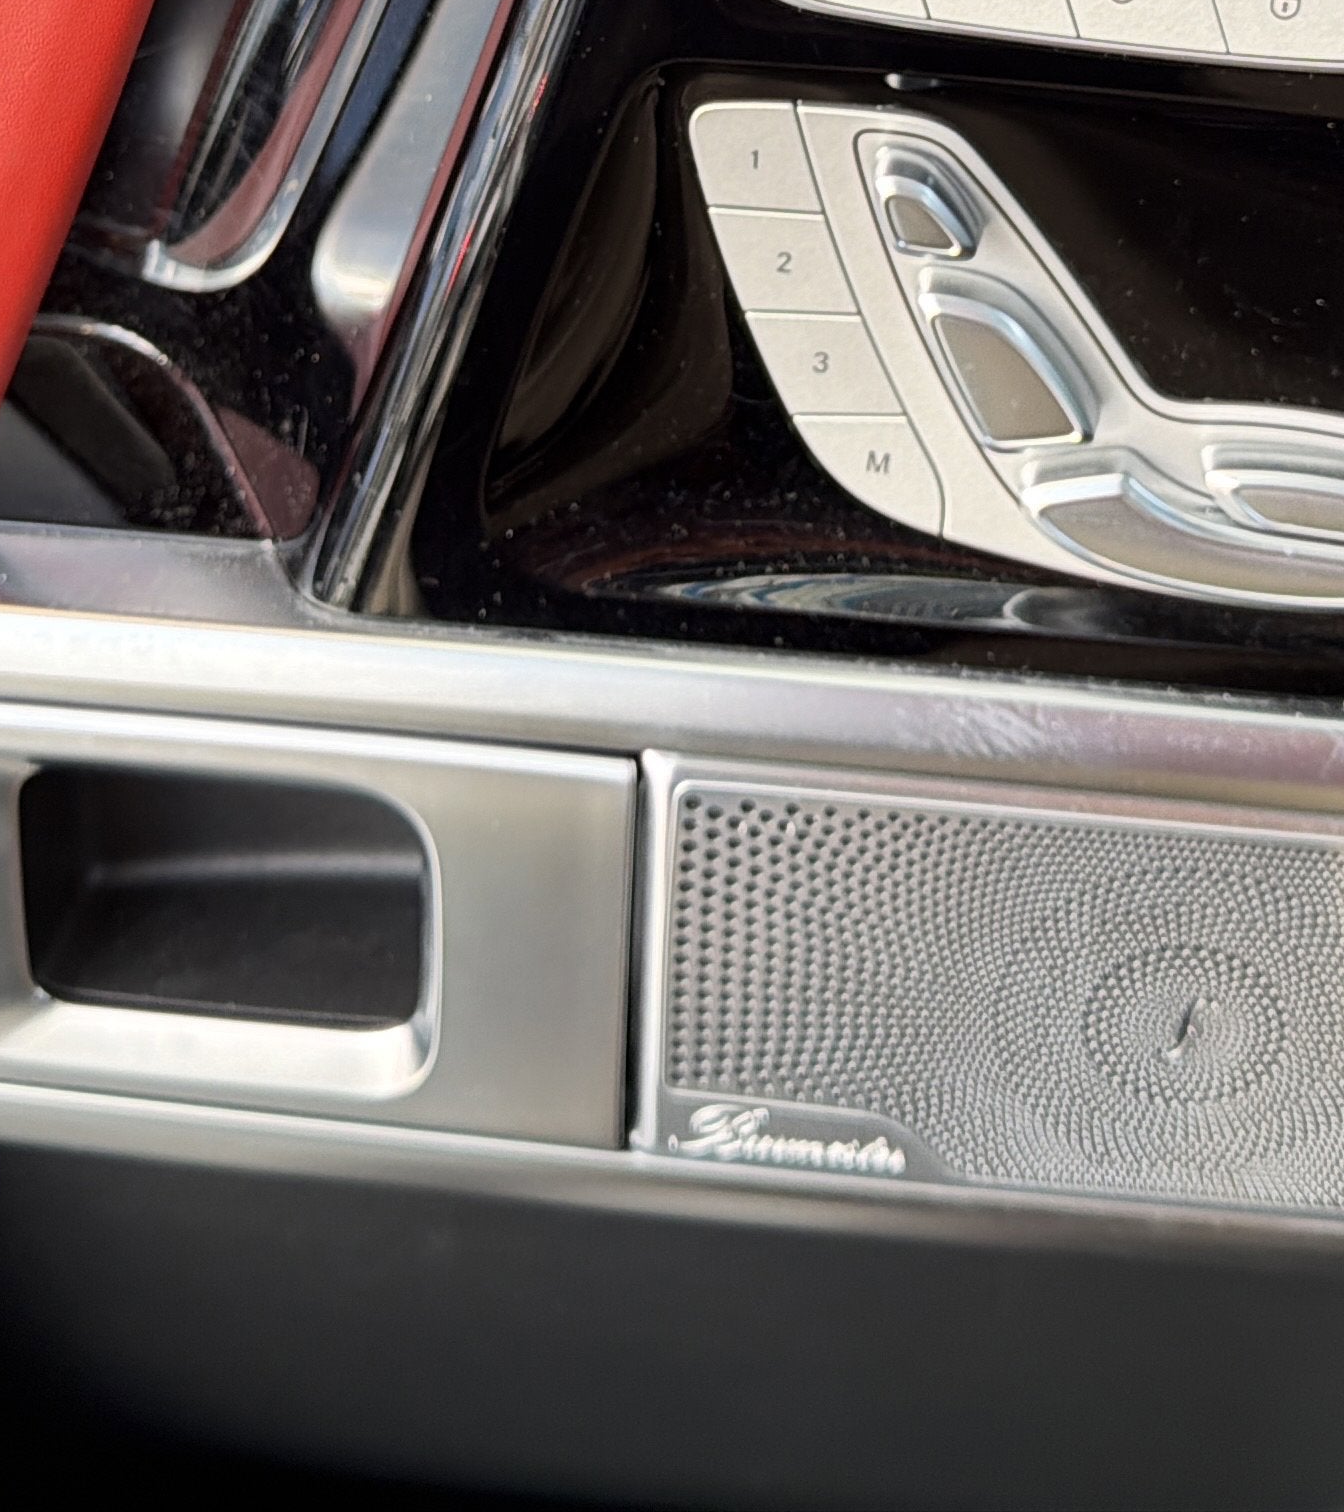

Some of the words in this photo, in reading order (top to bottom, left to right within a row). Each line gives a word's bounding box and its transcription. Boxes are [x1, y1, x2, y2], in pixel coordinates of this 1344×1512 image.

[751, 149, 759, 170] 1
[776, 251, 793, 274] 2
[812, 351, 829, 374] 3
[865, 450, 891, 475] M
